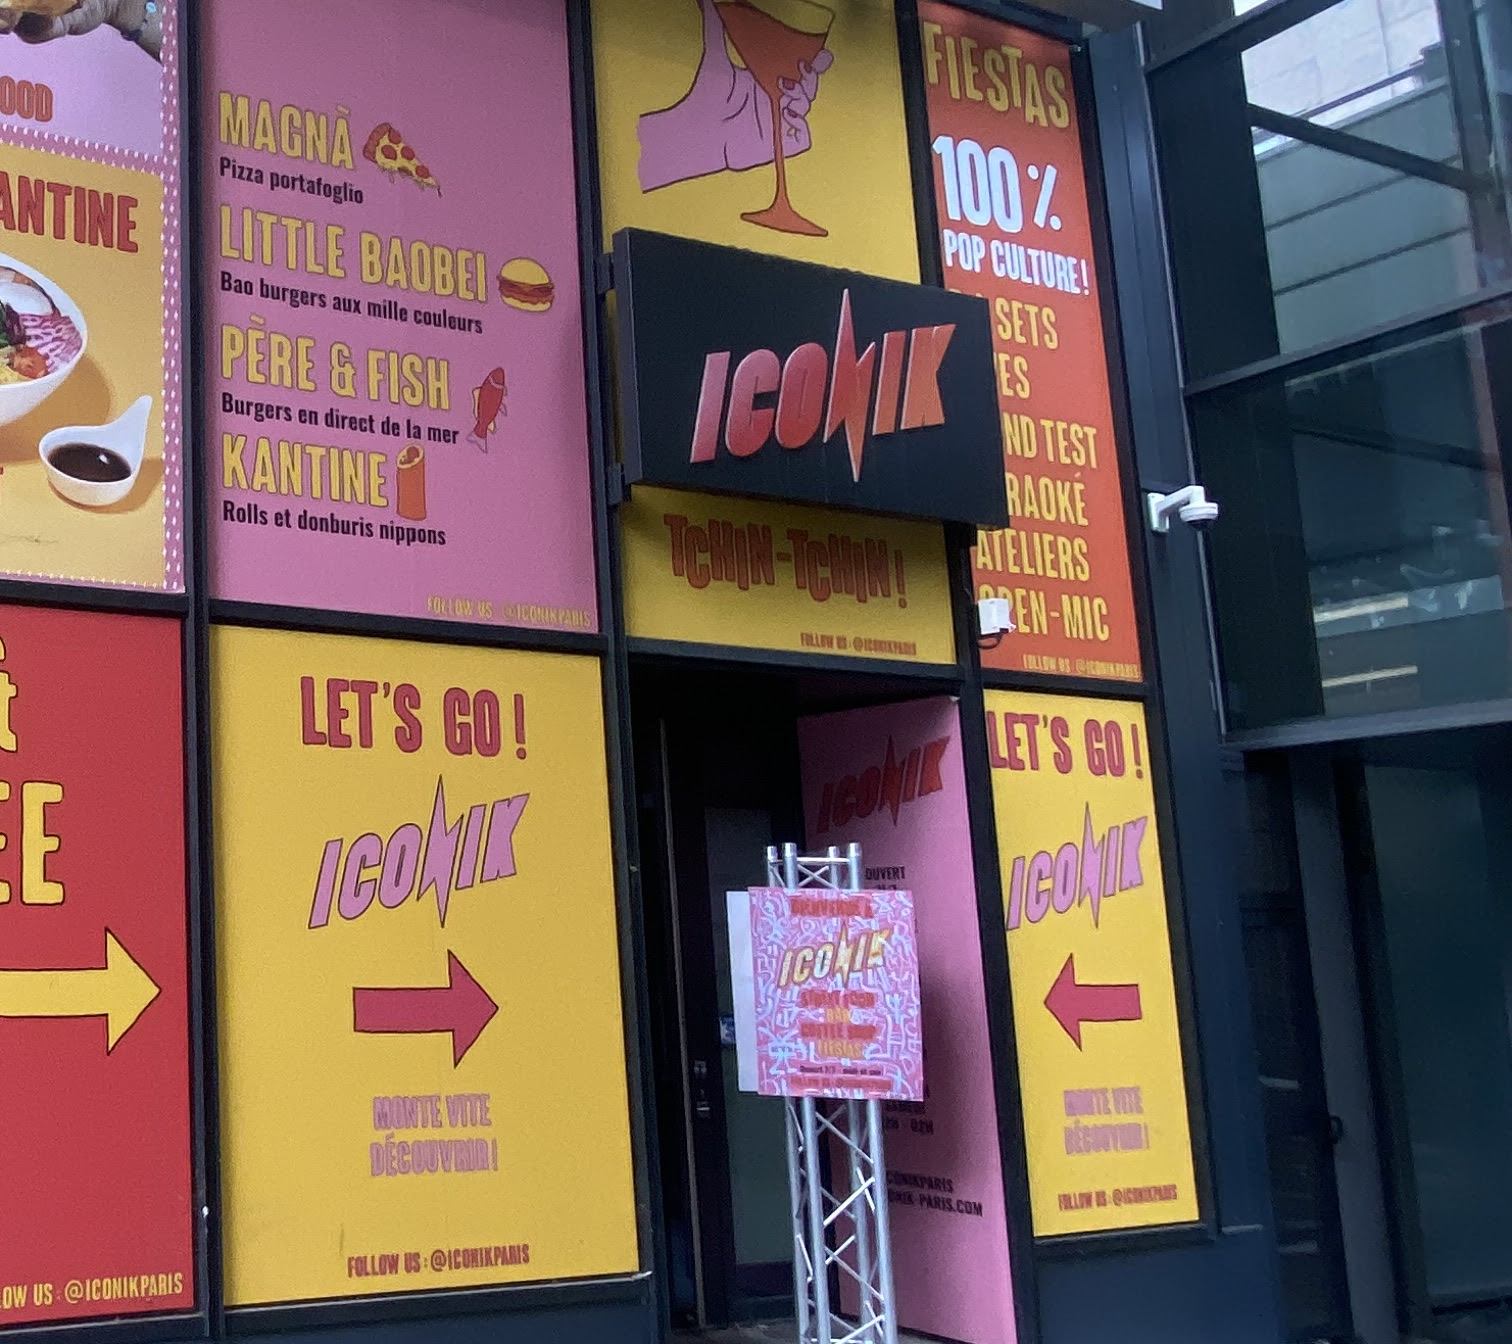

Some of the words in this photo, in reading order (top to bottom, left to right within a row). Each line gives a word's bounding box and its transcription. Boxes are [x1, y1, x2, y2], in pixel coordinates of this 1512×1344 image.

[922, 21, 1070, 129] FIESTAS
[219, 156, 263, 184] Pizza
[270, 172, 363, 204] portafoglio
[220, 205, 345, 278] LITTLE
[360, 232, 488, 302] BAOBEI
[943, 229, 985, 273] POP
[221, 271, 254, 295] Bao
[260, 283, 326, 309] burgers
[333, 296, 362, 315] aux
[367, 301, 408, 323] mille
[414, 307, 483, 334] couleurs
[995, 297, 1058, 350] SETS
[330, 341, 355, 398] &
[368, 350, 451, 410] FISH
[690, 288, 956, 482] ICONIK
[222, 393, 292, 422] Burgers
[298, 405, 319, 426] en
[324, 409, 375, 434] direct
[381, 417, 401, 437] de
[407, 419, 422, 440] la
[428, 427, 459, 444] mer
[1040, 418, 1097, 469] TEST
[222, 434, 388, 507] KANTINE
[223, 500, 268, 526] Rolls
[275, 507, 291, 528] et
[298, 509, 373, 538] donburis
[379, 521, 447, 546] nippons
[976, 529, 1090, 582] ATELIERS
[300, 676, 423, 753] LET'S
[987, 710, 1074, 774] LET'S
[818, 734, 951, 833] ICONIK
[308, 774, 530, 930] ICONIK
[865, 866, 905, 880] OUVERT
[1006, 800, 1148, 932] ICONIK
[778, 917, 892, 988] ICONIK
[446, 1093, 492, 1128] VITE
[33, 1283, 53, 1306] US
[64, 1272, 183, 1304] @ICONIKPARIS
[348, 1254, 399, 1278] FOLLOW
[404, 1252, 420, 1273] US
